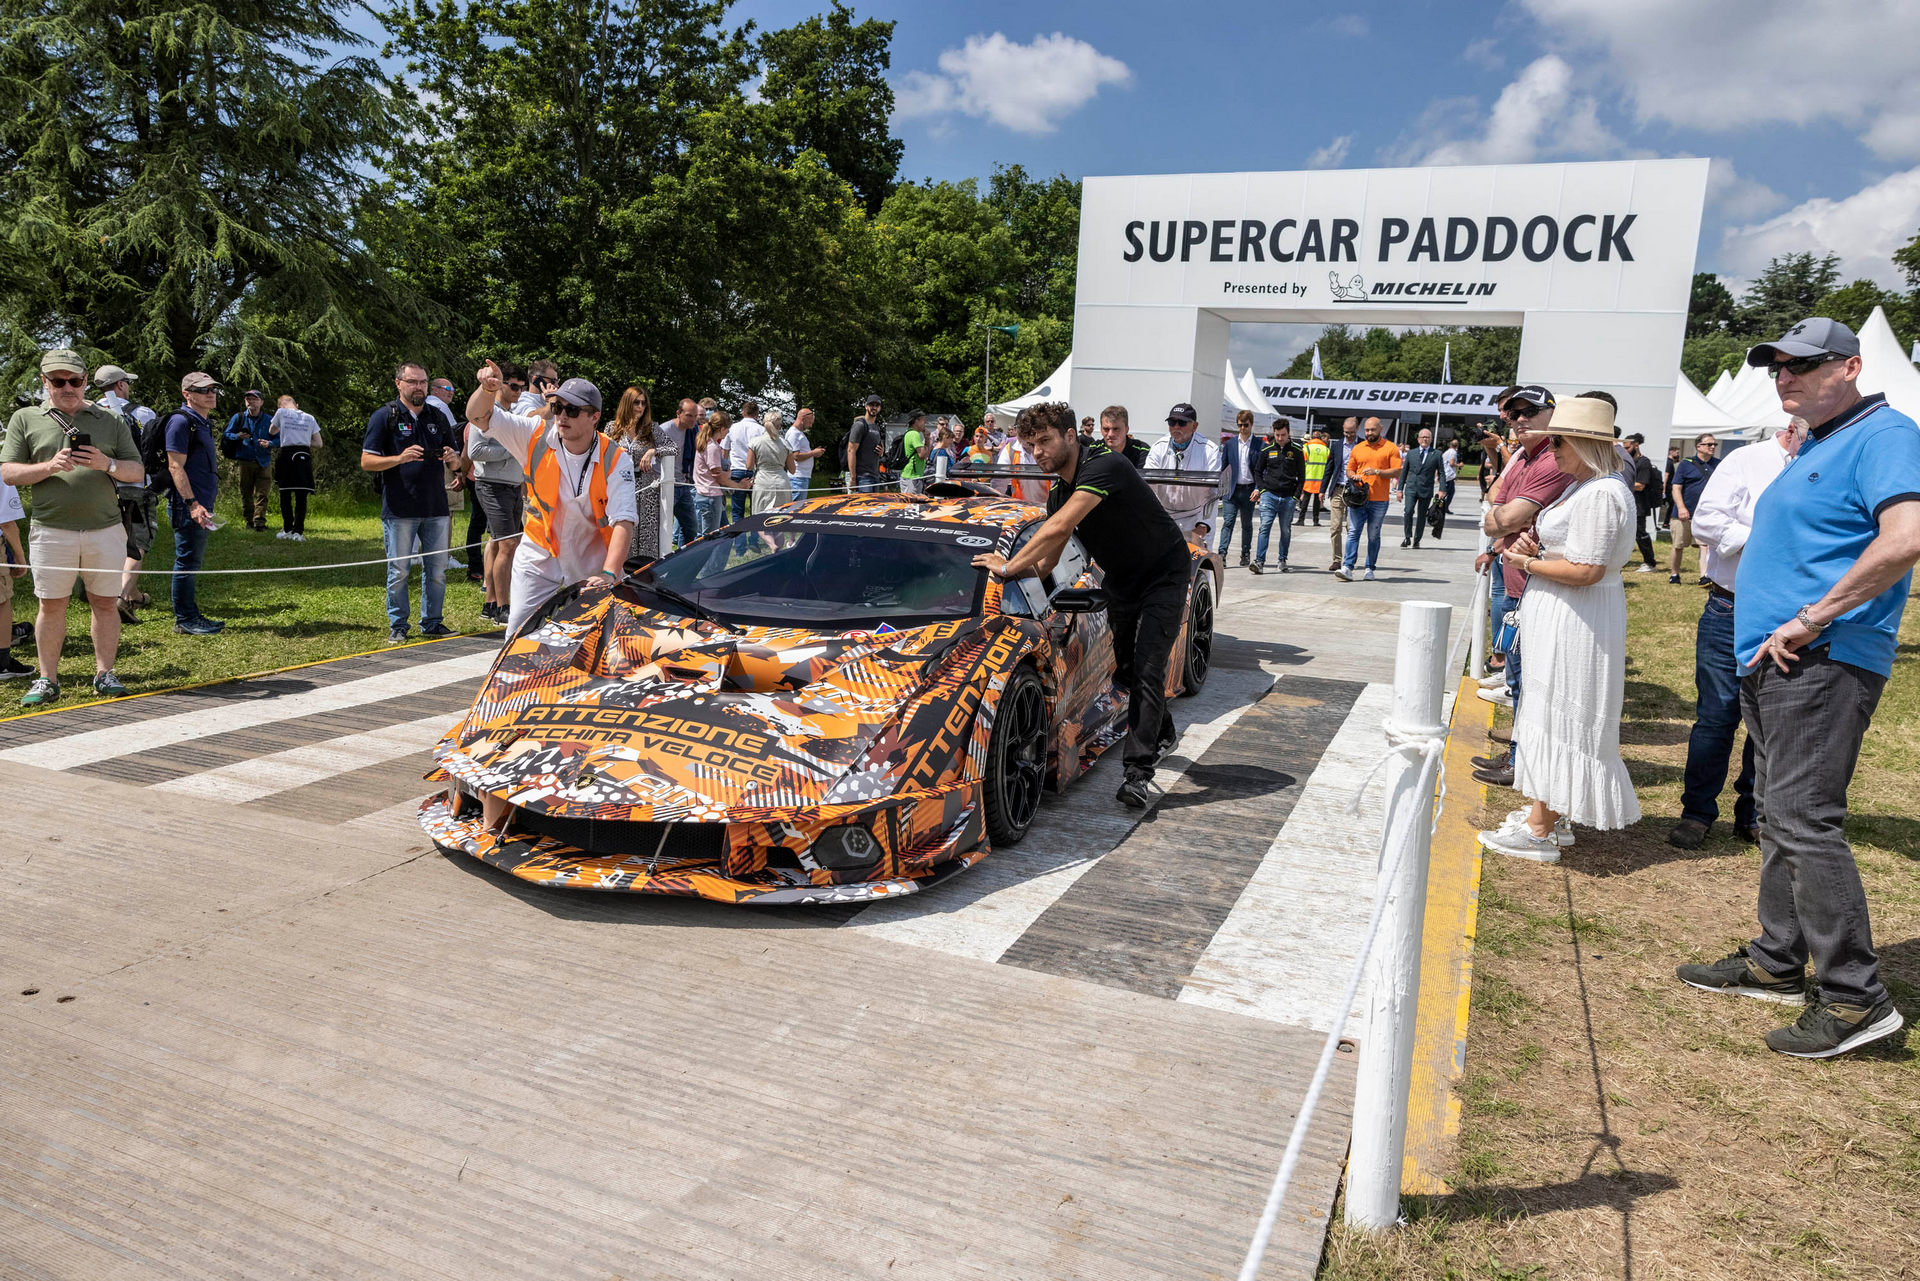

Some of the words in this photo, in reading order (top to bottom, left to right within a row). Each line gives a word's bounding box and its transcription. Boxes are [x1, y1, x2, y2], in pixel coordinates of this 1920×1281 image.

[1123, 218, 1359, 263] SUPERCAR
[1377, 214, 1638, 262] PADDOCK
[1223, 281, 1287, 295] Presented
[1292, 283, 1308, 297] by
[1371, 282, 1497, 296] MICHELIN
[1262, 386, 1364, 401] MICHELIN
[1366, 389, 1484, 406] SUPERCAR
[790, 519, 885, 529] SQUADRA
[894, 524, 970, 535] CORSE
[961, 537, 987, 545] 629
[522, 706, 768, 754] ATTENZIONE
[644, 736, 777, 782] VELOCE
